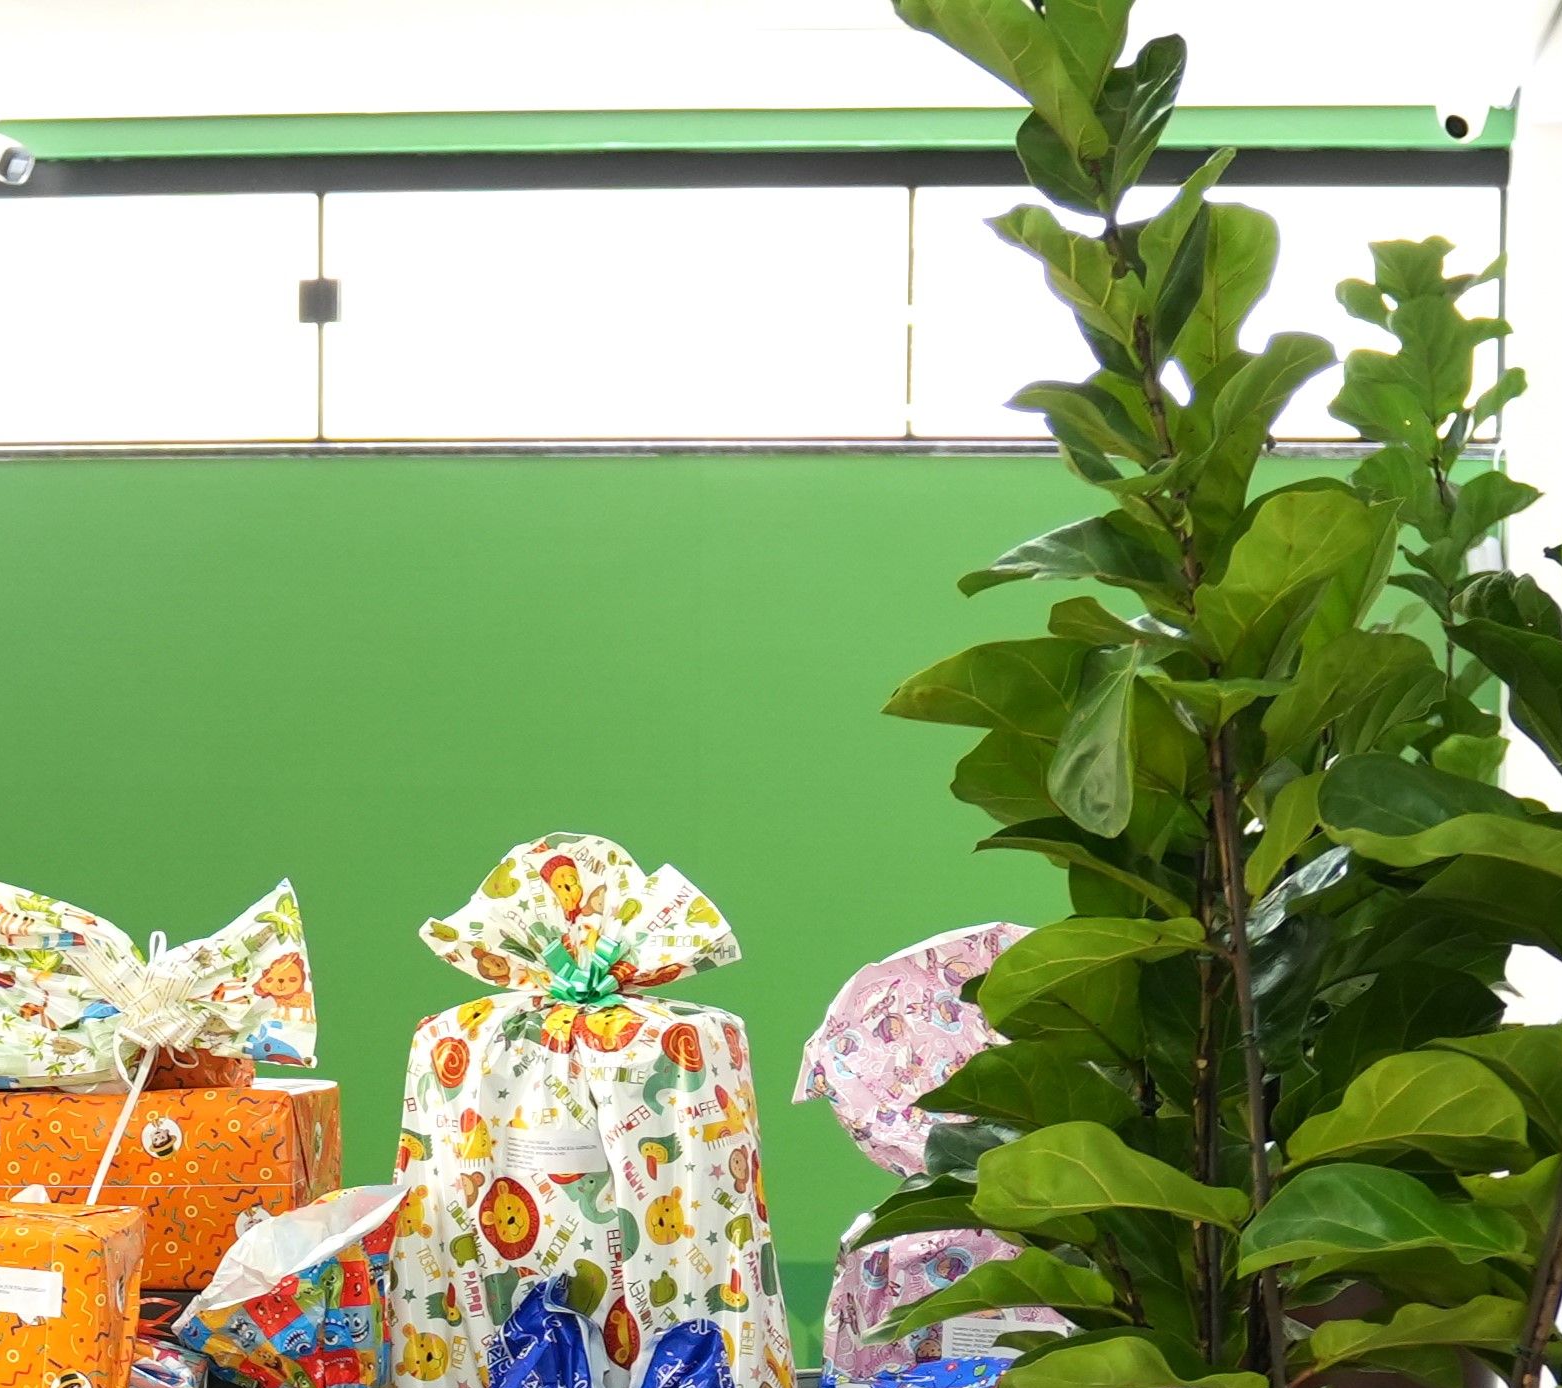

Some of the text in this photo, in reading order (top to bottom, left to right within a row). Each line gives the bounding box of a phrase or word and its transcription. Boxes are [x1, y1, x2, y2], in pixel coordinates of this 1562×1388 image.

[531, 1172, 559, 1206] LION
[416, 1244, 443, 1283] TIGER
[606, 1229, 624, 1292] ELEPHANT
[740, 1321, 756, 1357] TIGER
